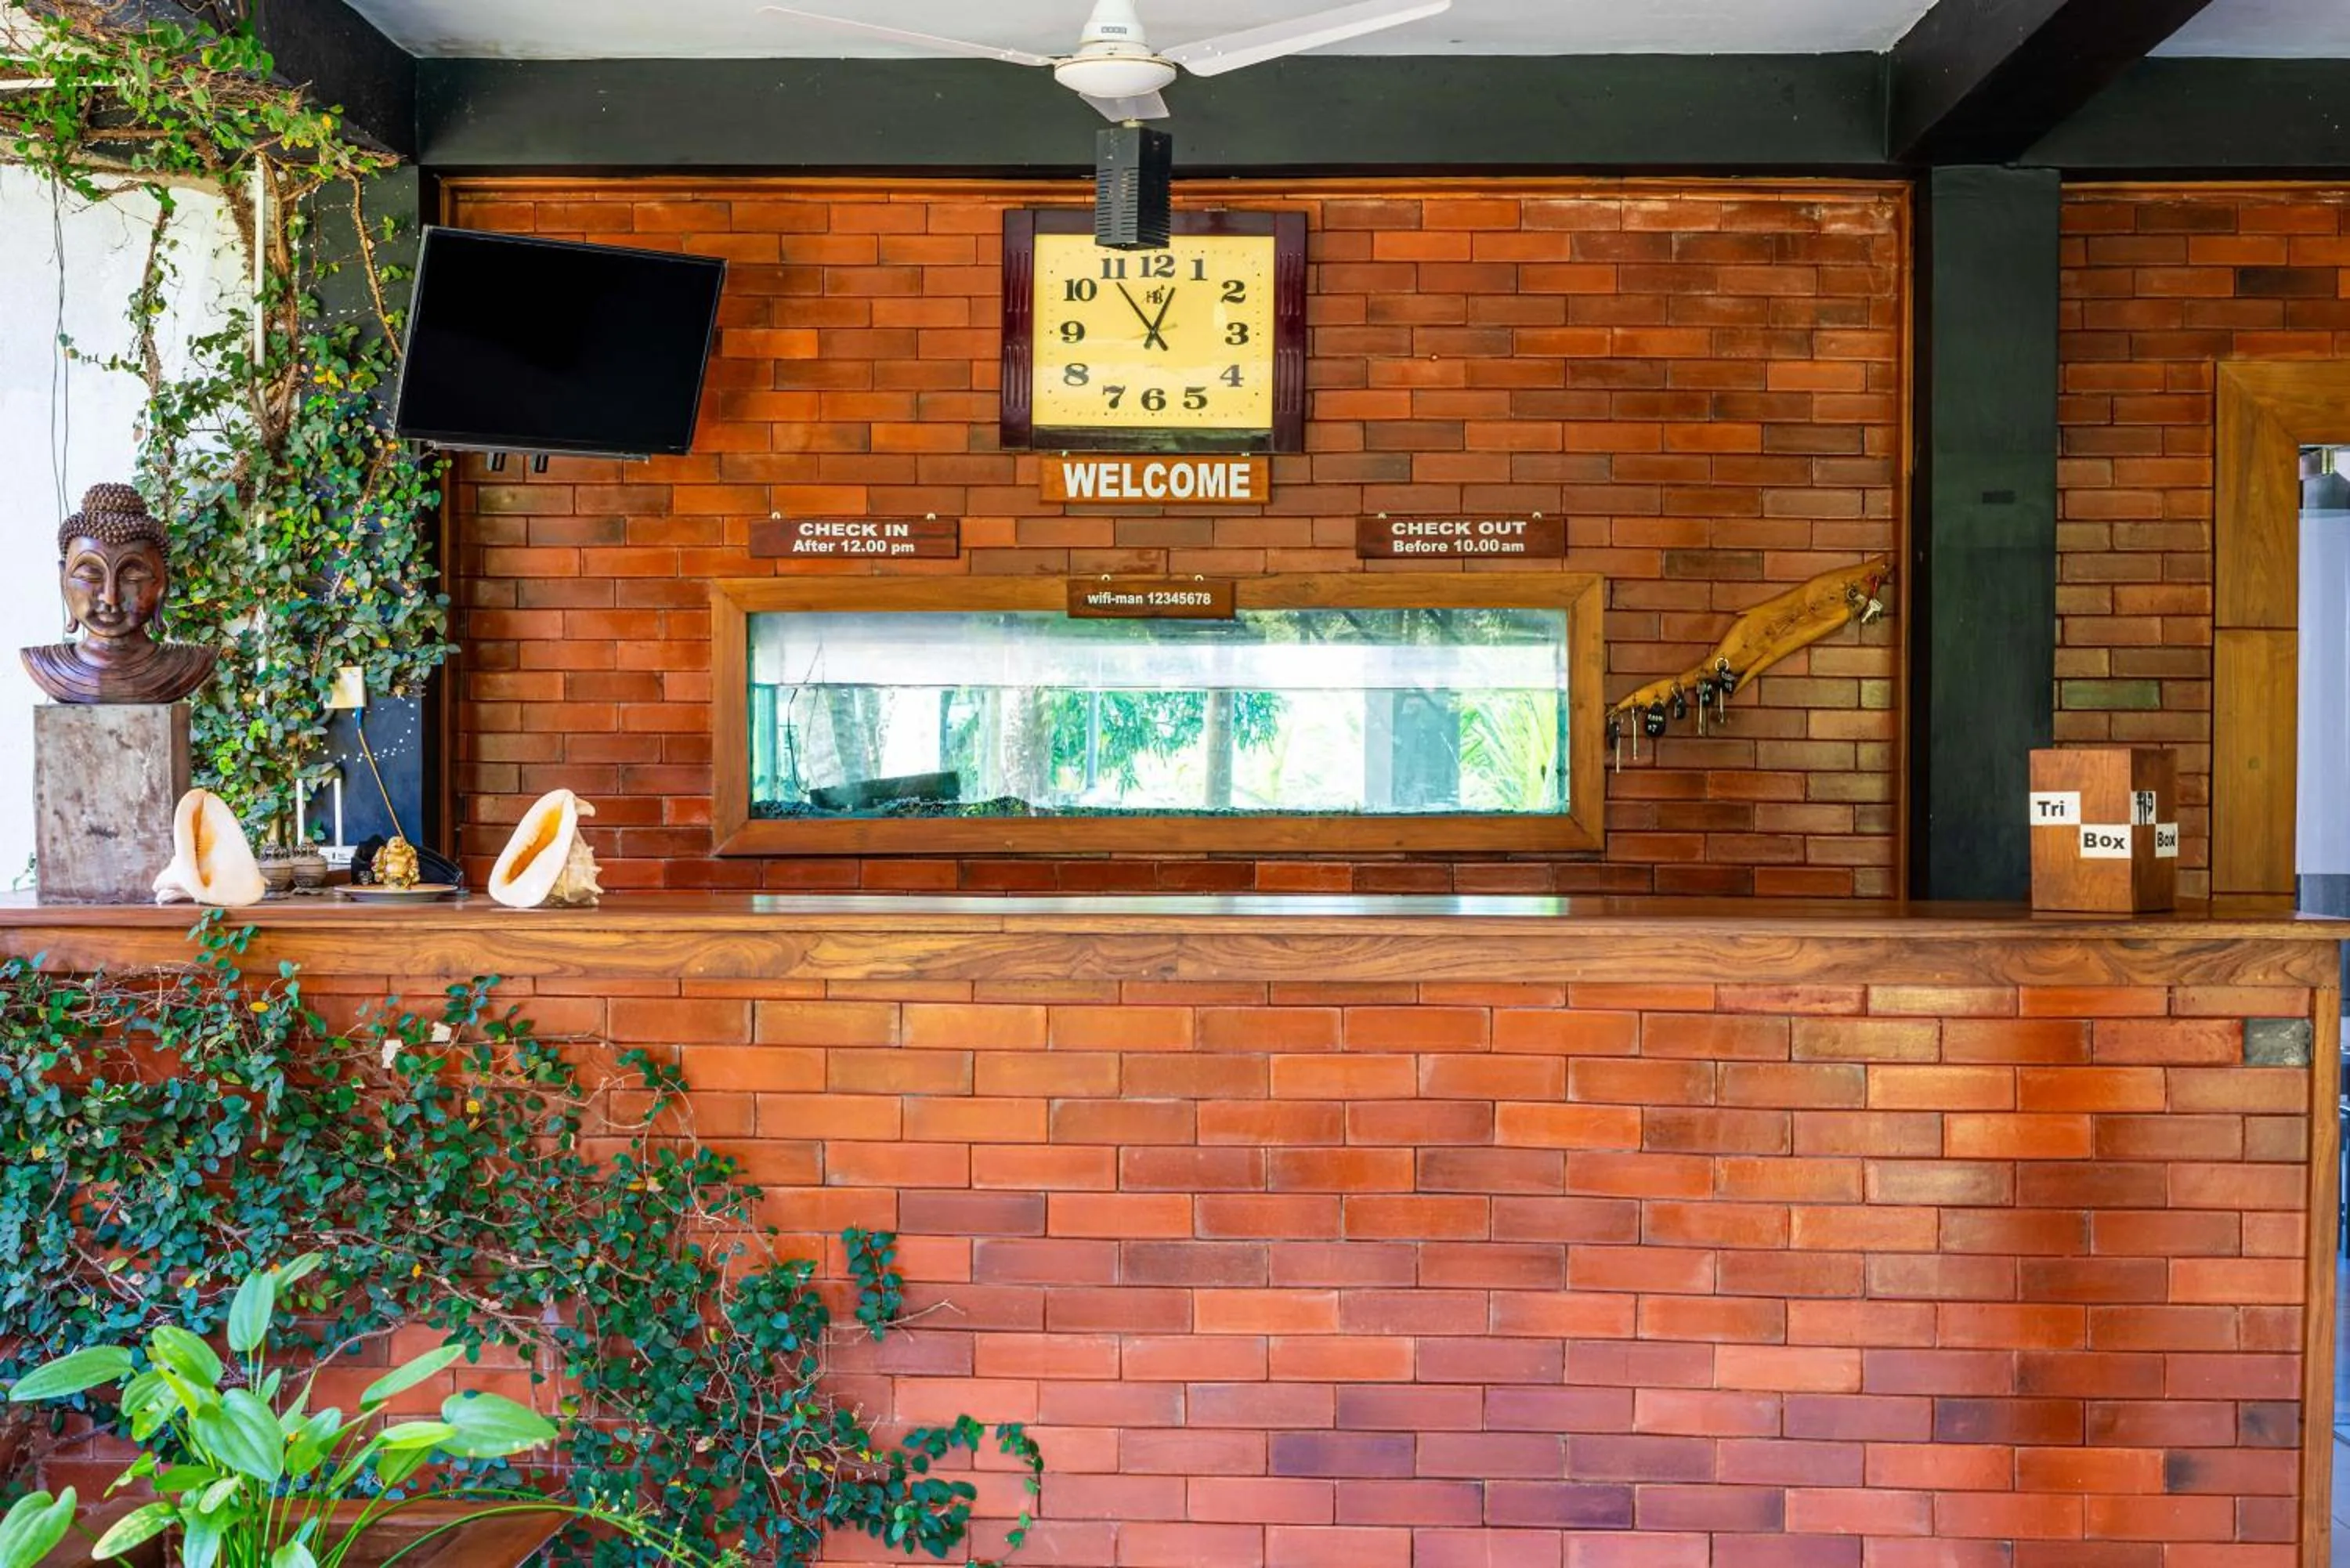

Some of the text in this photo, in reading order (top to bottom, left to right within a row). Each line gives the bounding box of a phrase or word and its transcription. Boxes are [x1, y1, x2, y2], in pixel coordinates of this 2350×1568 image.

[1100, 257, 1127, 280] 11
[1138, 255, 1175, 278] 12
[1190, 258, 1208, 280] 1
[1063, 278, 1097, 302] 10
[1220, 280, 1246, 303] 2
[1060, 320, 1086, 343] 9
[1225, 322, 1249, 345] 3
[1063, 363, 1090, 386] 8
[1219, 364, 1244, 387] 4
[1102, 385, 1126, 409] 7
[1141, 388, 1166, 411] 6
[1183, 386, 1208, 410] 5
[1063, 462, 1251, 498] WELCOME
[799, 522, 909, 537] CHECK IN
[1391, 522, 1527, 535] CHECK OUT
[793, 540, 915, 555] After 12.00 pm
[1393, 539, 1525, 552] Before 10.00 am
[1087, 591, 1212, 605] wifi-man 12345678
[2037, 800, 2065, 816] Tri
[2084, 833, 2125, 849] Box
[2157, 831, 2176, 847] Box
